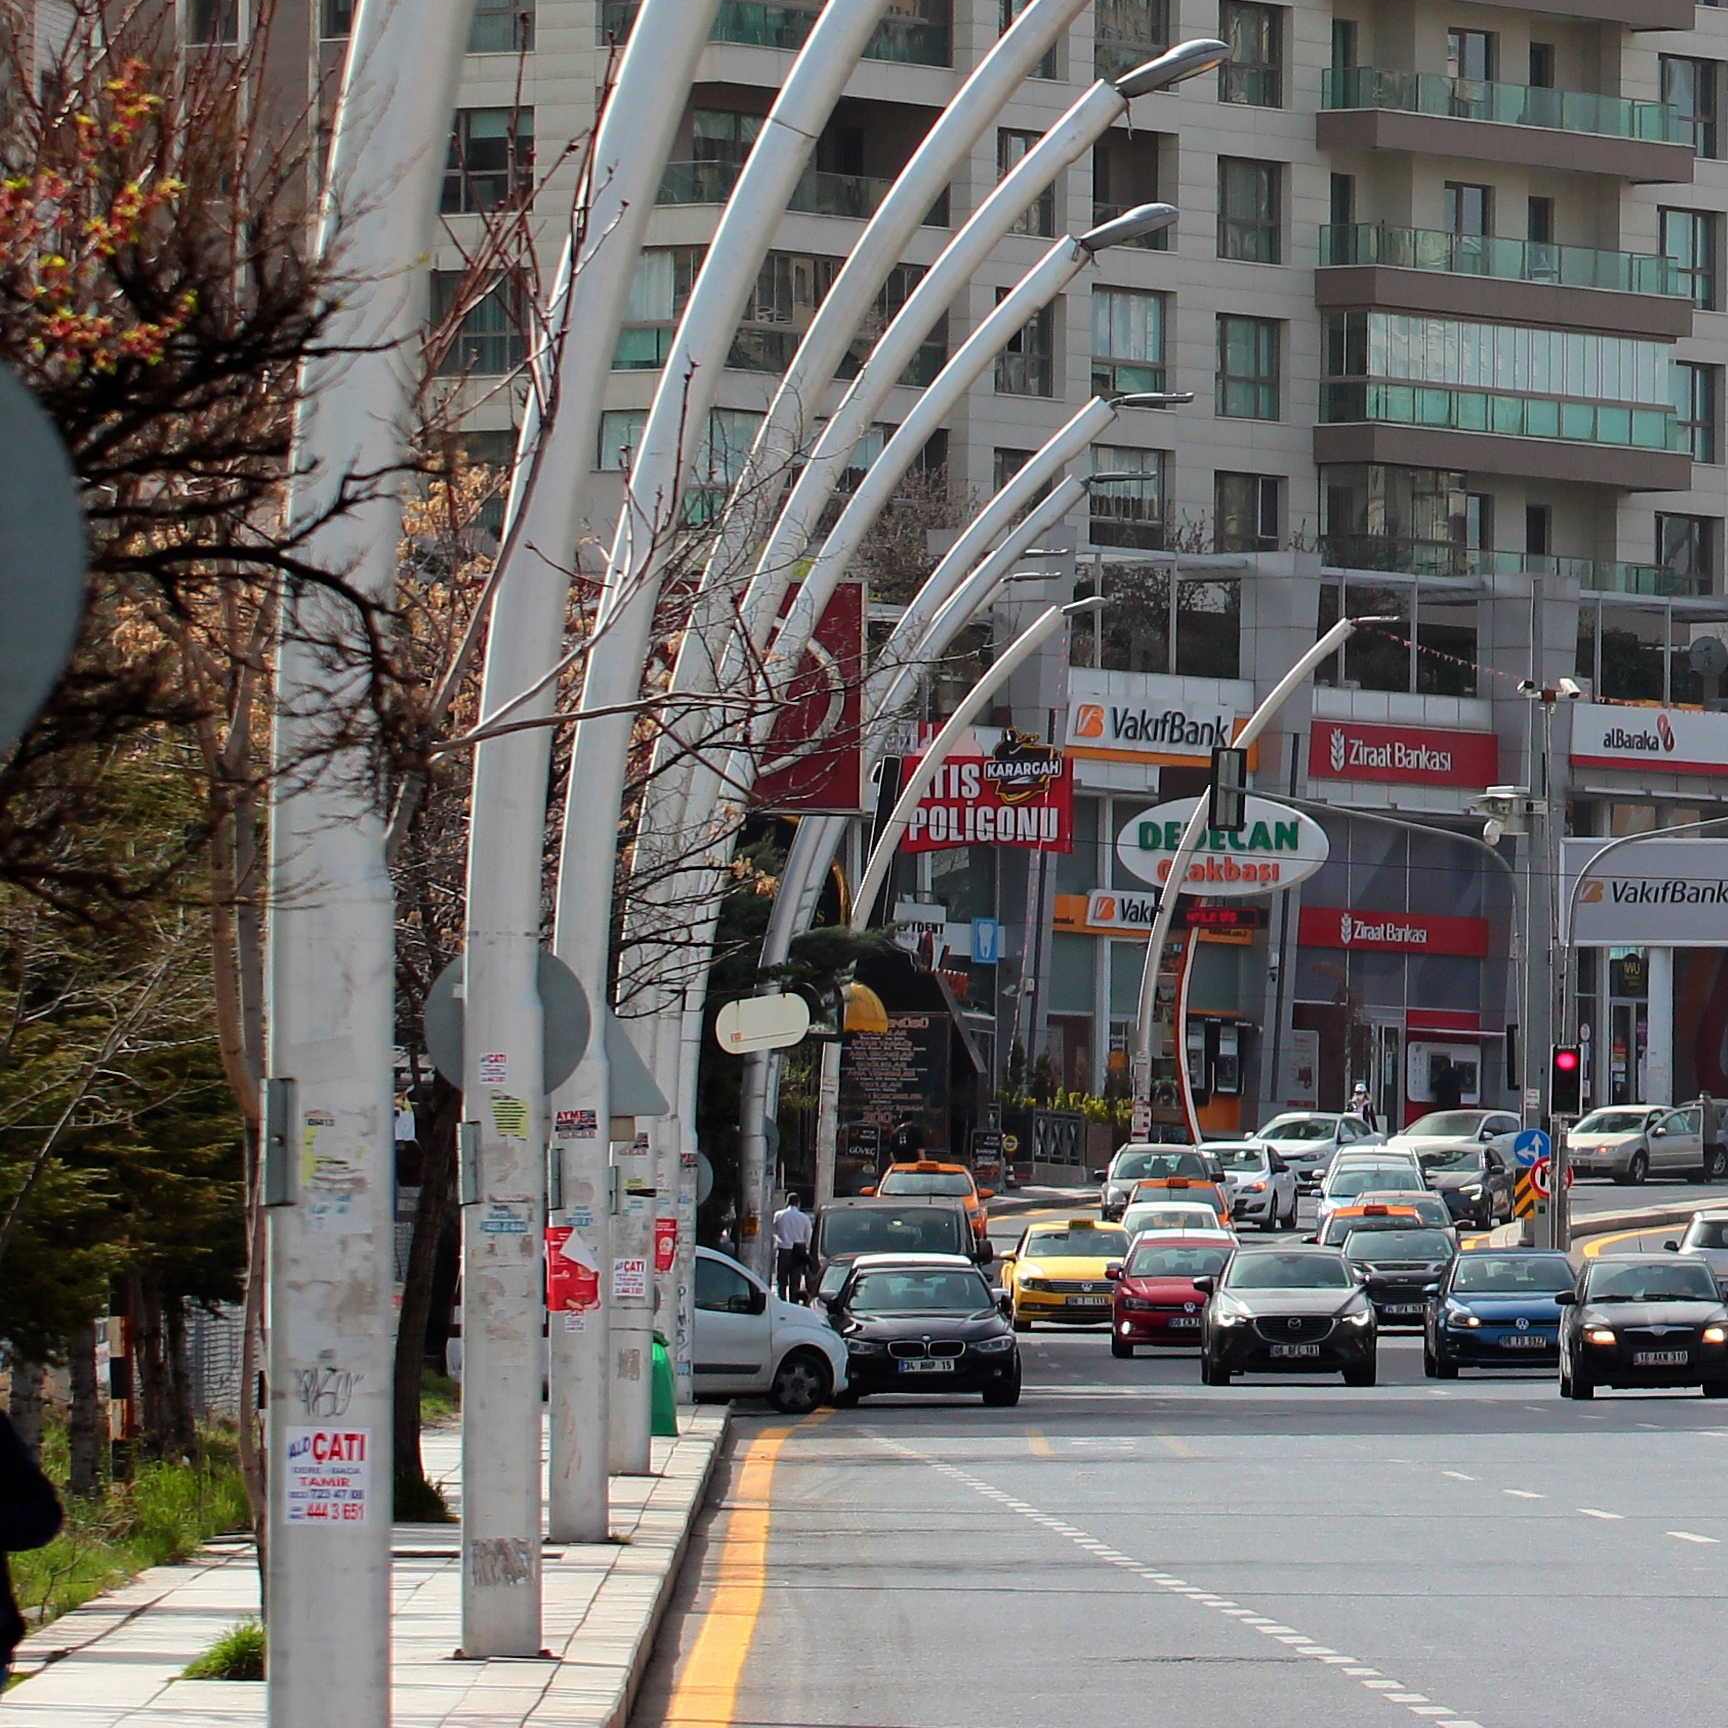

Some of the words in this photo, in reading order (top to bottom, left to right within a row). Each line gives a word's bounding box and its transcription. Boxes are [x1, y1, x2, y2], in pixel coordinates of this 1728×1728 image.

[1112, 706, 1231, 747] VakıfBank
[1603, 728, 1660, 752] alBaraka
[986, 761, 1060, 777] KARARGAH
[1349, 738, 1393, 768] Ziraat
[1394, 741, 1452, 772] Bankası
[909, 799, 1059, 842] POLİGONU
[1156, 856, 1280, 886] Oakbaşı
[1354, 920, 1385, 941] Ziraat
[1386, 923, 1428, 943] Bankası
[312, 1432, 368, 1465] ÇATI
